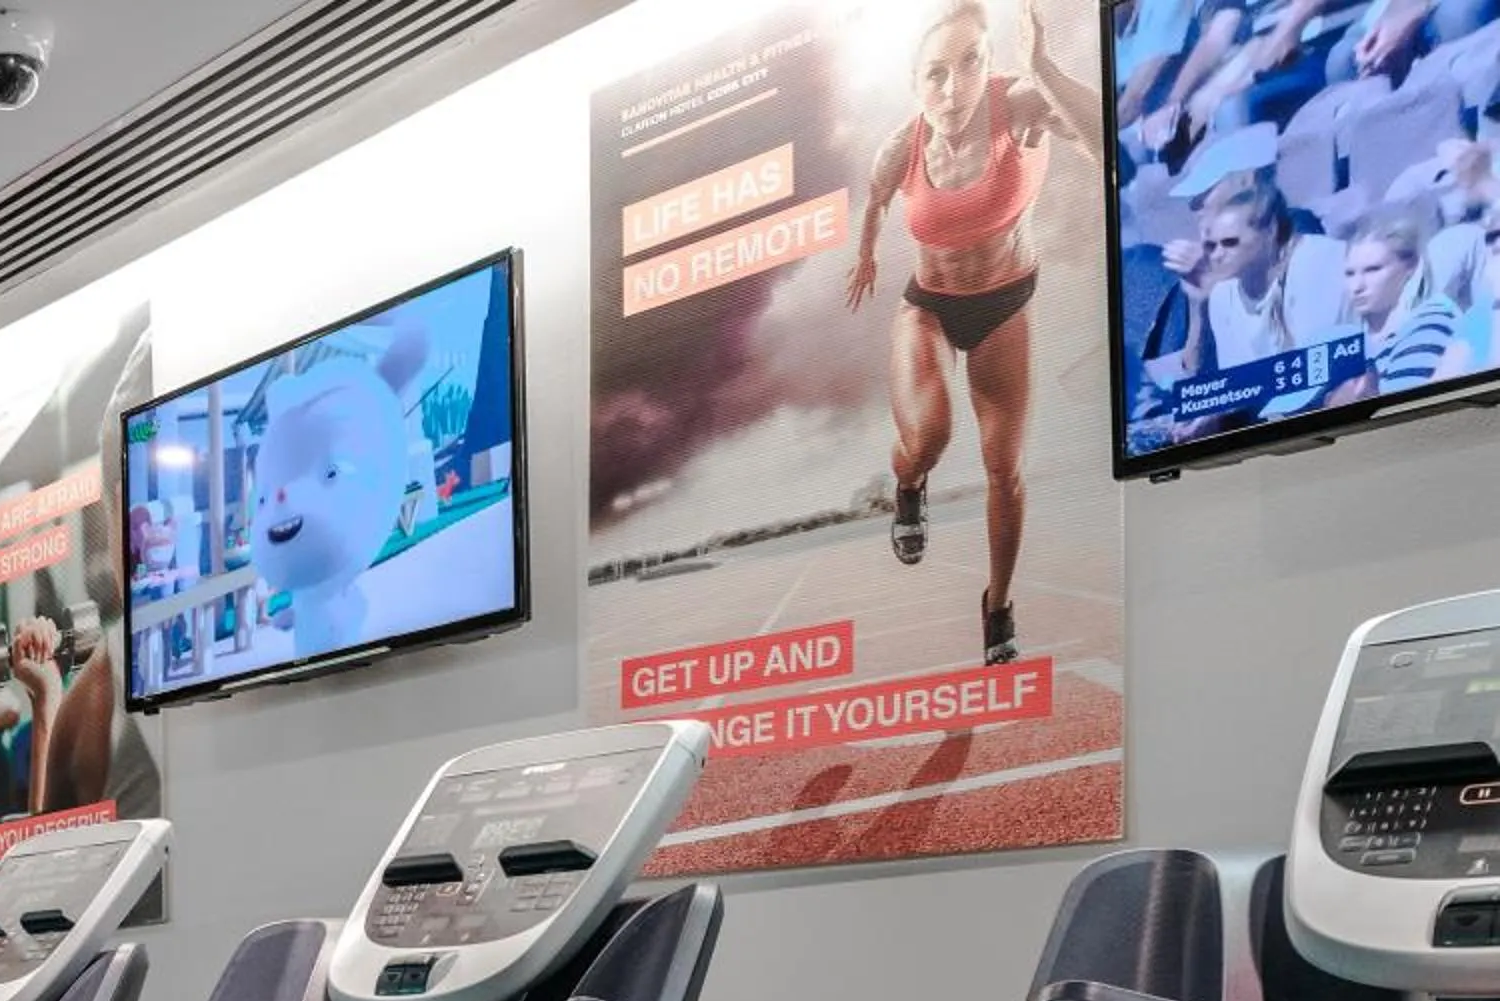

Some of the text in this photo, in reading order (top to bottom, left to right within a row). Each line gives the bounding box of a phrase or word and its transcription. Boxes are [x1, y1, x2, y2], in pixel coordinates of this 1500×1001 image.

[632, 159, 784, 243] LIFE HAS
[632, 204, 836, 300] NO REMOTE
[1332, 338, 1361, 360] Ad
[1181, 384, 1264, 415] Kuznetsov
[1, 504, 34, 532] ARE
[1, 532, 68, 576] STRONG
[631, 635, 842, 698] GET UP AND
[707, 671, 1040, 750] NGE IT YOURSELF
